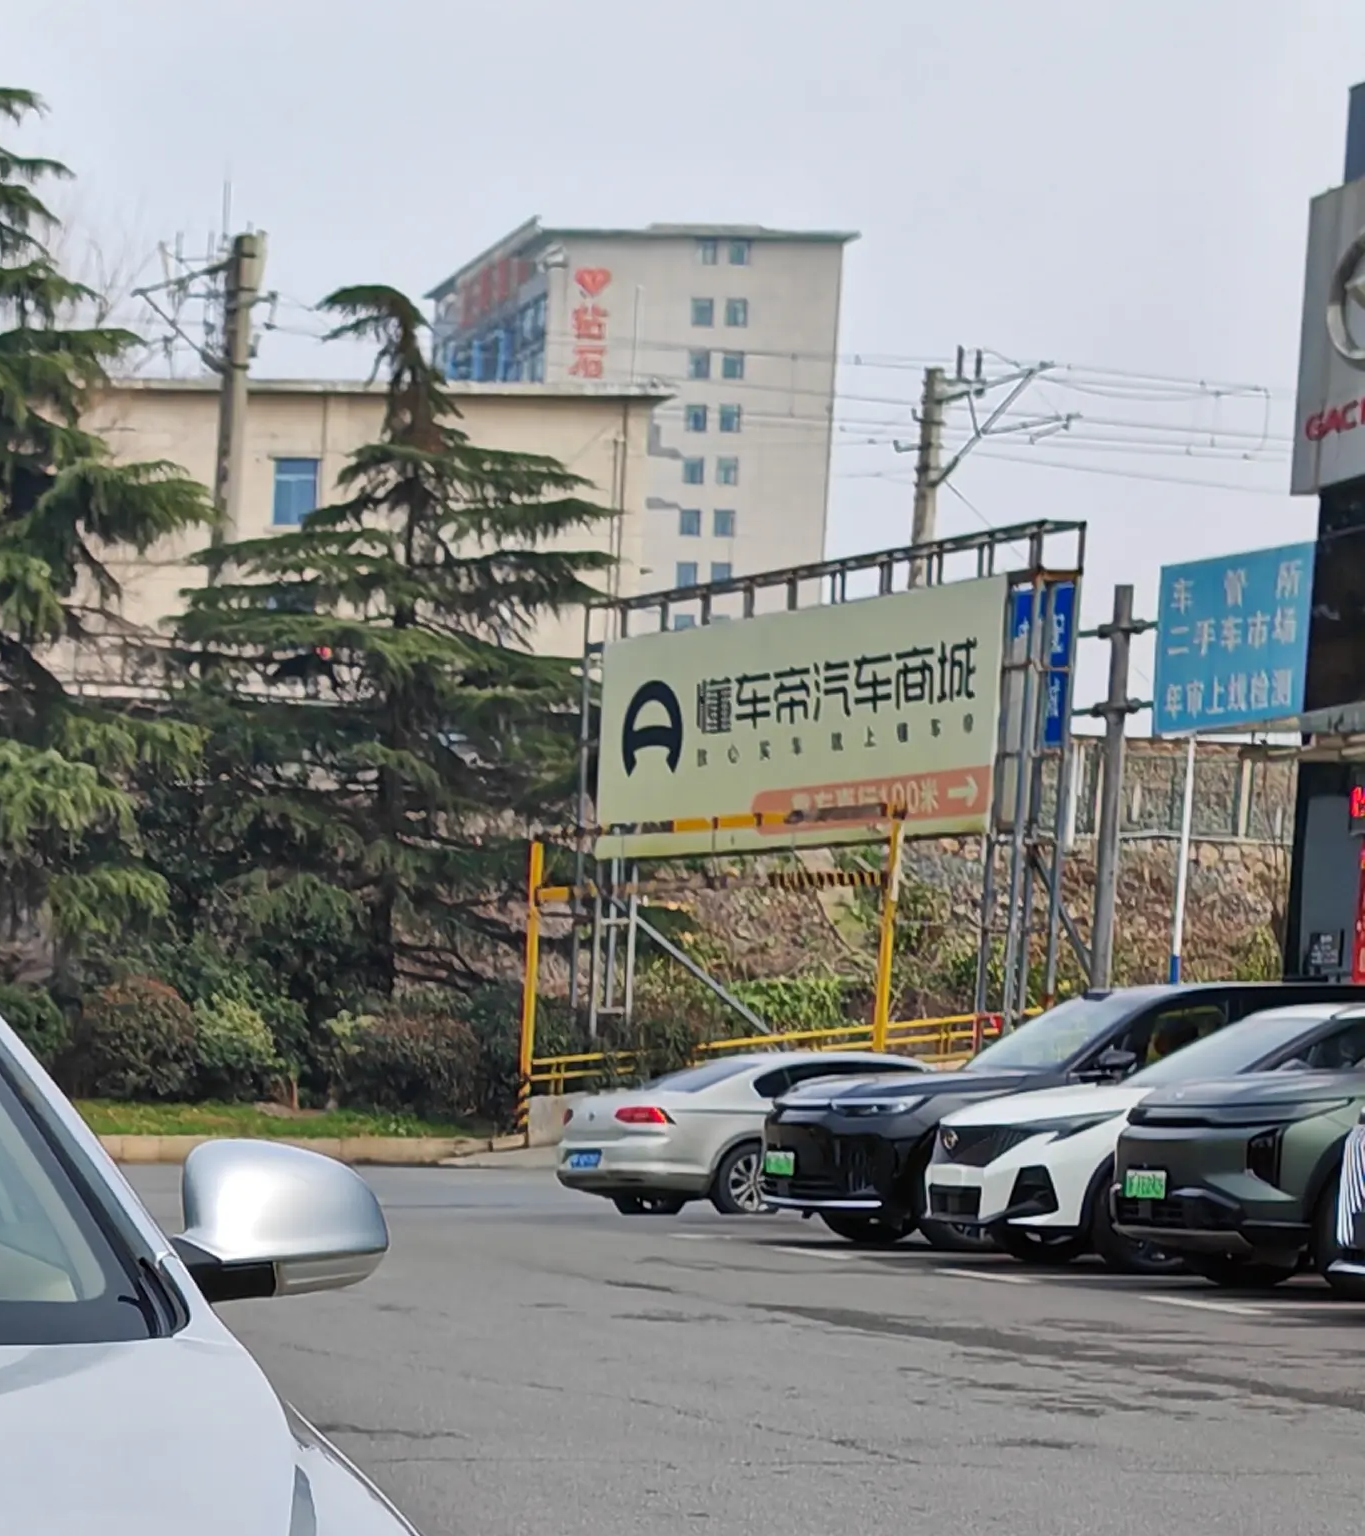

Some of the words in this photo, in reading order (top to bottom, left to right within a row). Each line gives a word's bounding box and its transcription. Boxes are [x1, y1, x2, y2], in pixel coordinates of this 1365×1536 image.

[1170, 560, 1303, 615] 车管所
[1167, 606, 1297, 657] 二手车市场
